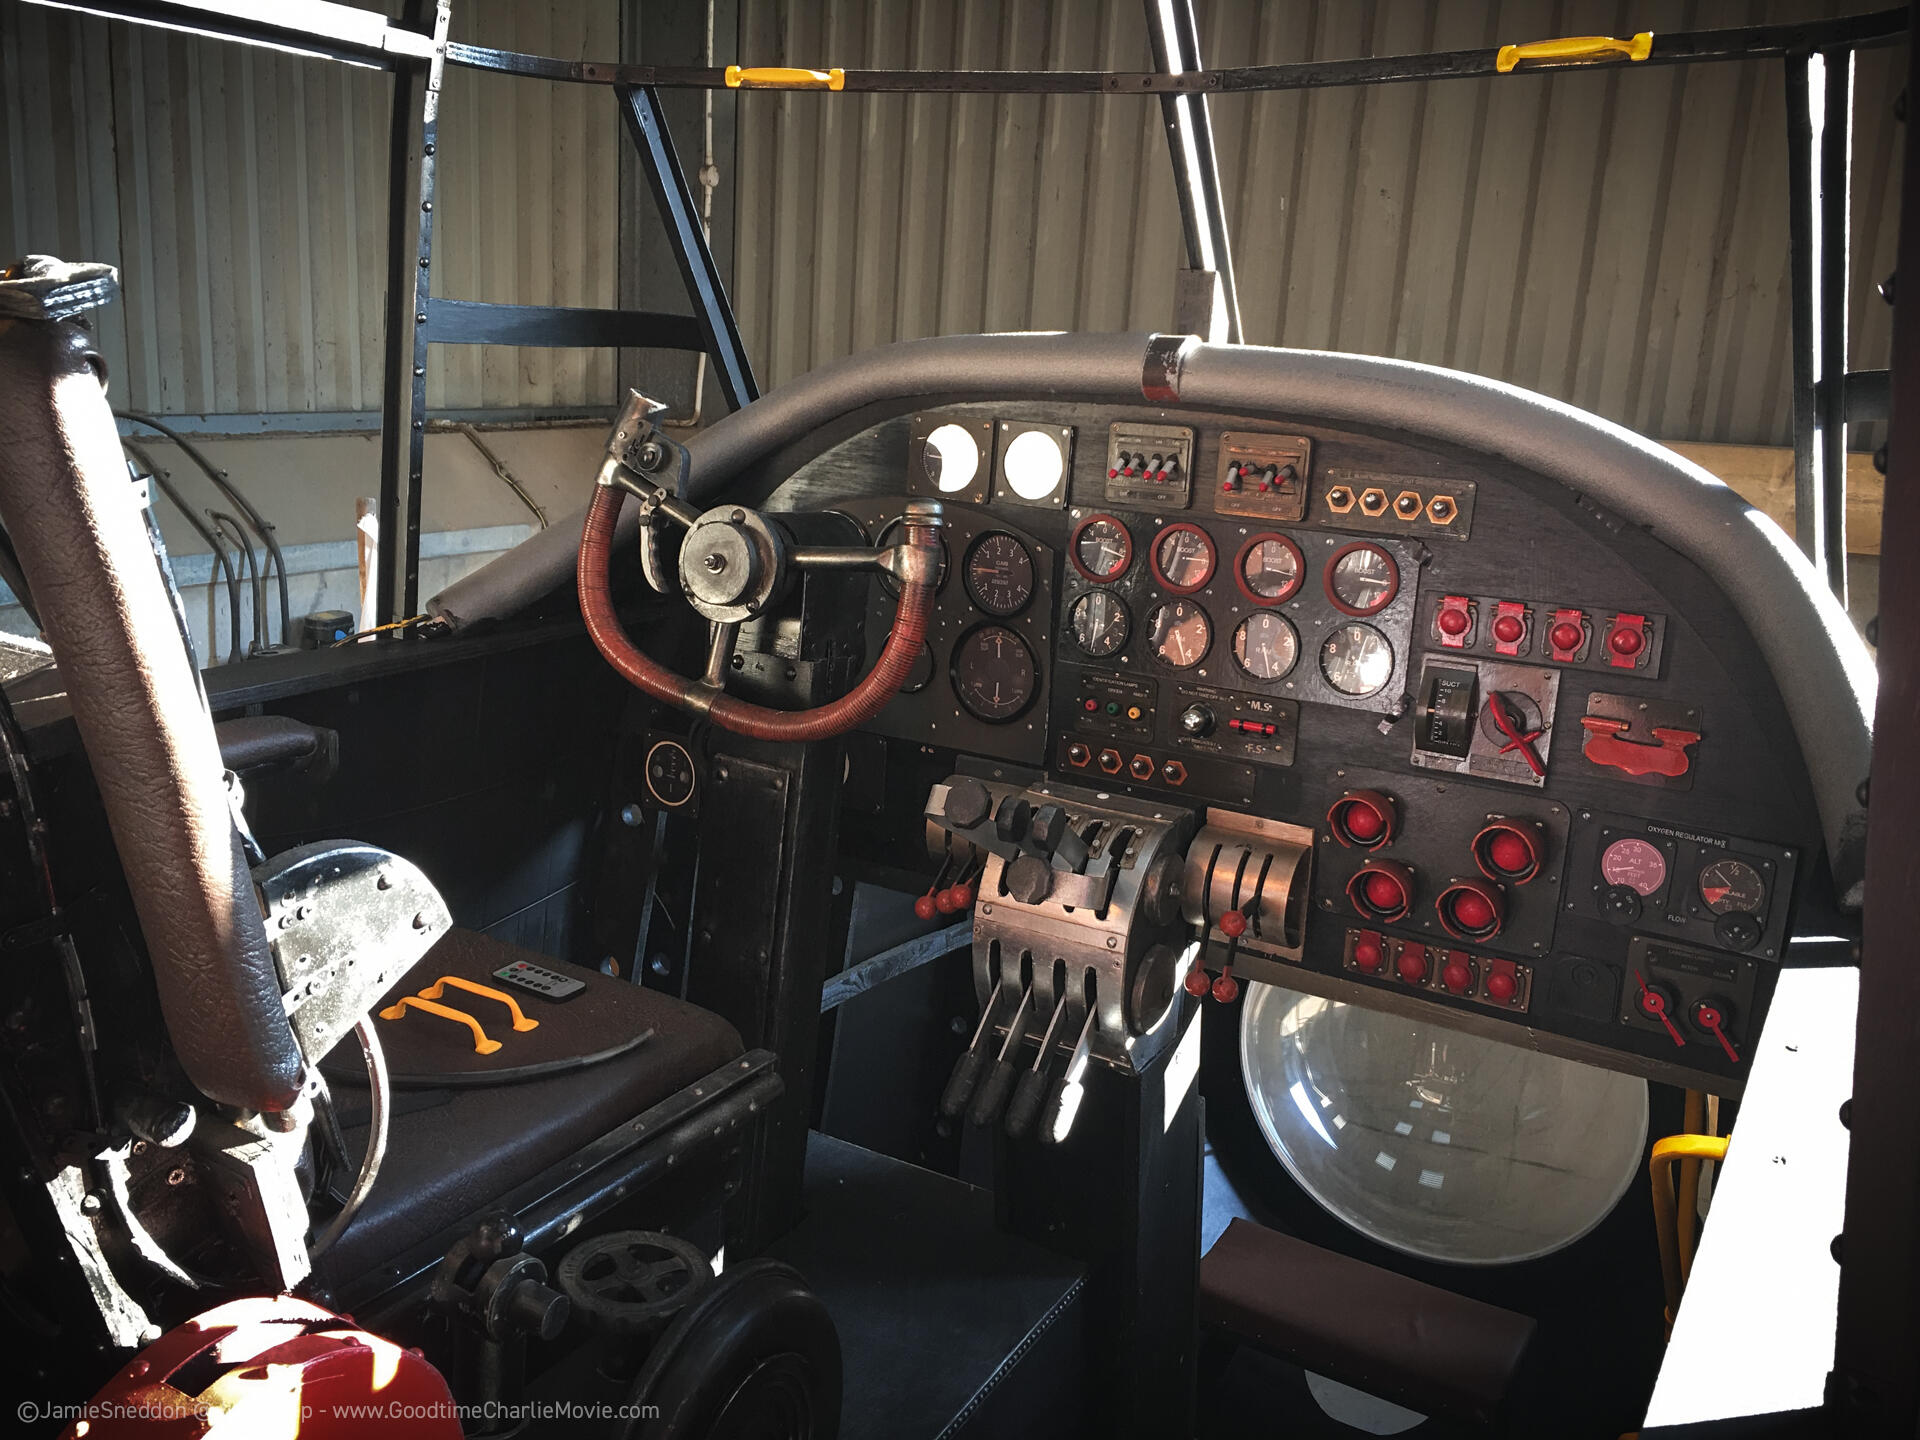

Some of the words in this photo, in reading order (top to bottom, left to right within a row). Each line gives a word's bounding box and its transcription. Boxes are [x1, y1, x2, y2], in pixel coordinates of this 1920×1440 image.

[1009, 549, 1014, 557] 3
[1096, 596, 1101, 605] 0
[1076, 608, 1080, 617] 8
[1176, 607, 1183, 616] 0
[1114, 612, 1120, 622] 2
[1155, 619, 1161, 628] 8
[1263, 619, 1269, 628] 0
[1196, 624, 1203, 634] 2
[1080, 633, 1085, 642] 6
[1240, 631, 1246, 640] 8
[1354, 631, 1360, 641] 0
[1104, 636, 1110, 646] 4
[1283, 636, 1290, 647] 2
[1159, 646, 1165, 654] 6
[1185, 648, 1192, 657] 4
[1330, 644, 1336, 653] 8
[1244, 658, 1251, 667] 6
[1272, 661, 1278, 671] 4
[1441, 680, 1461, 688] SUCT
[1648, 825, 1674, 836] OXYGEN
[1675, 830, 1713, 844] REGULATOR
[1668, 914, 1686, 923] FLOW
